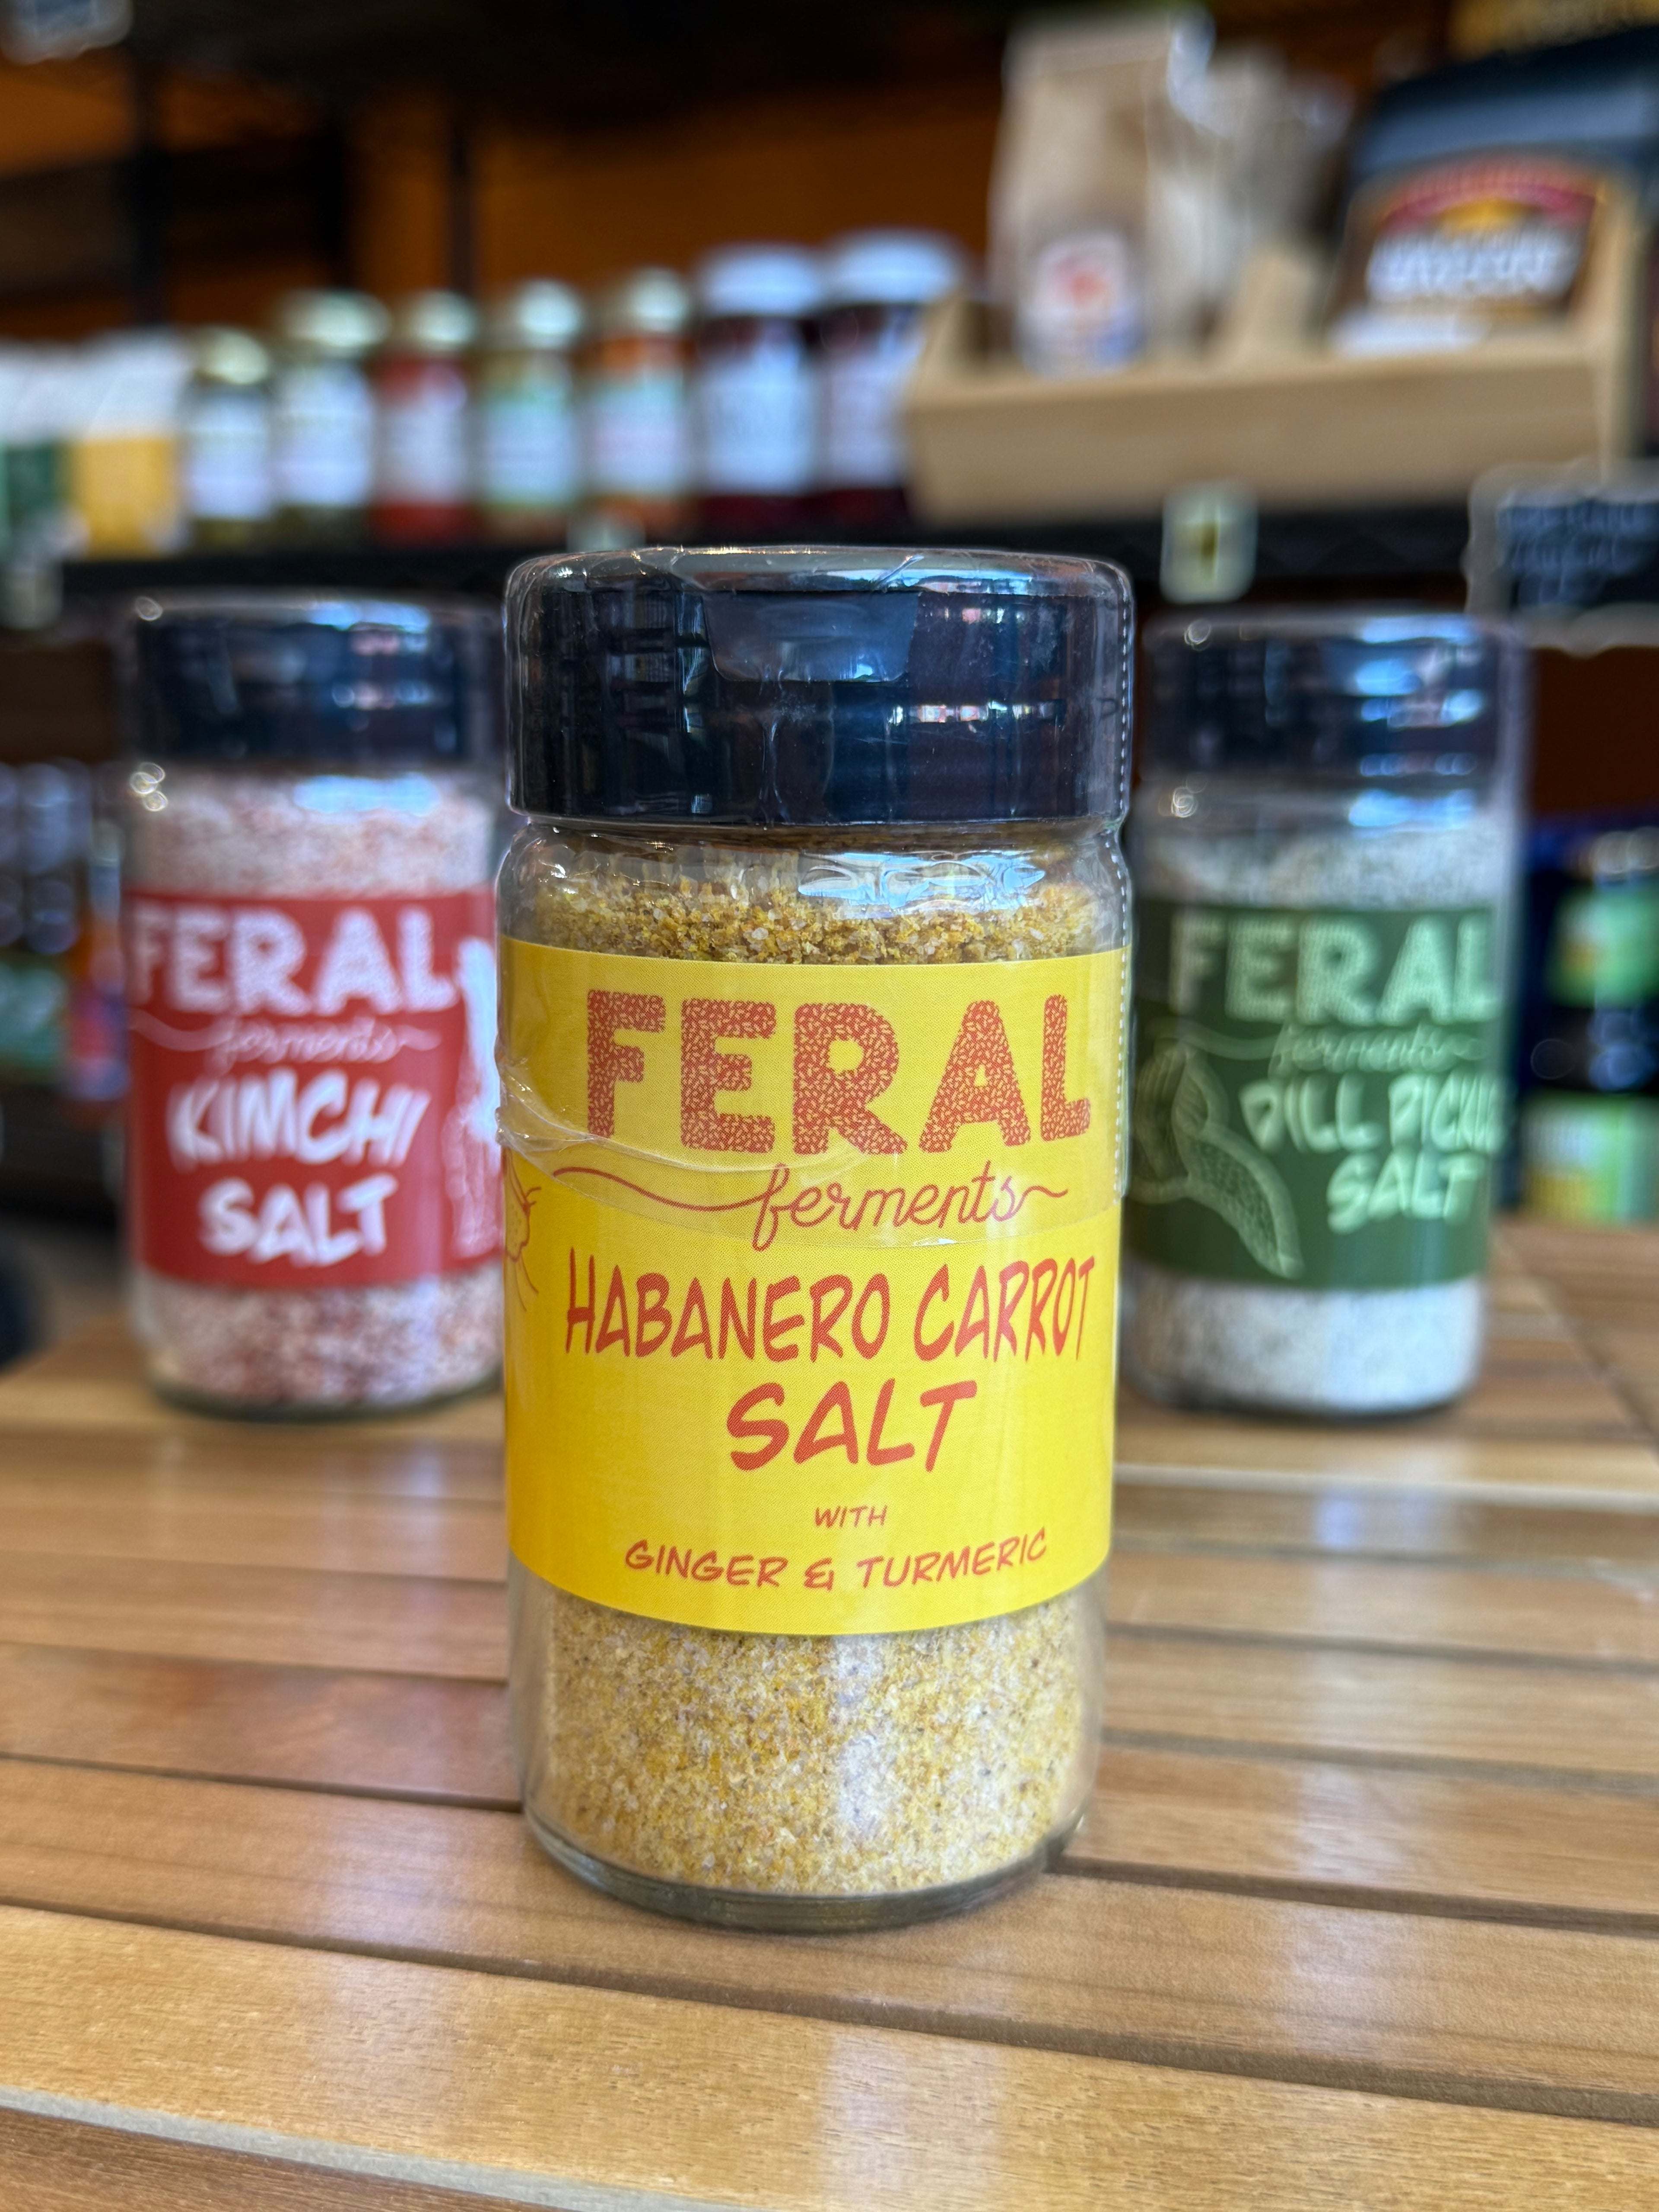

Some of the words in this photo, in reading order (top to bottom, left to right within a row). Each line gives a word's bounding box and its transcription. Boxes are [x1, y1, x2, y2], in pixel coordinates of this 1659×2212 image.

[129, 905, 458, 1016] FERAL
[1169, 909, 1503, 1025] FERAL
[587, 988, 1091, 1154] FERAL
[1238, 1071, 1382, 1156] DILL
[167, 1068, 429, 1170] KIMCHI
[199, 1172, 397, 1267] SALT
[1326, 1149, 1484, 1233] SALT
[565, 1247, 890, 1362] HABANERO
[913, 1256, 1095, 1362] CARROT
[725, 1378, 978, 1472] SALT
[625, 1540, 788, 1588] GINGER
[804, 1557, 835, 1590] &
[857, 1527, 1047, 1589] TURMERIC
[814, 1505, 887, 1528] WITH
